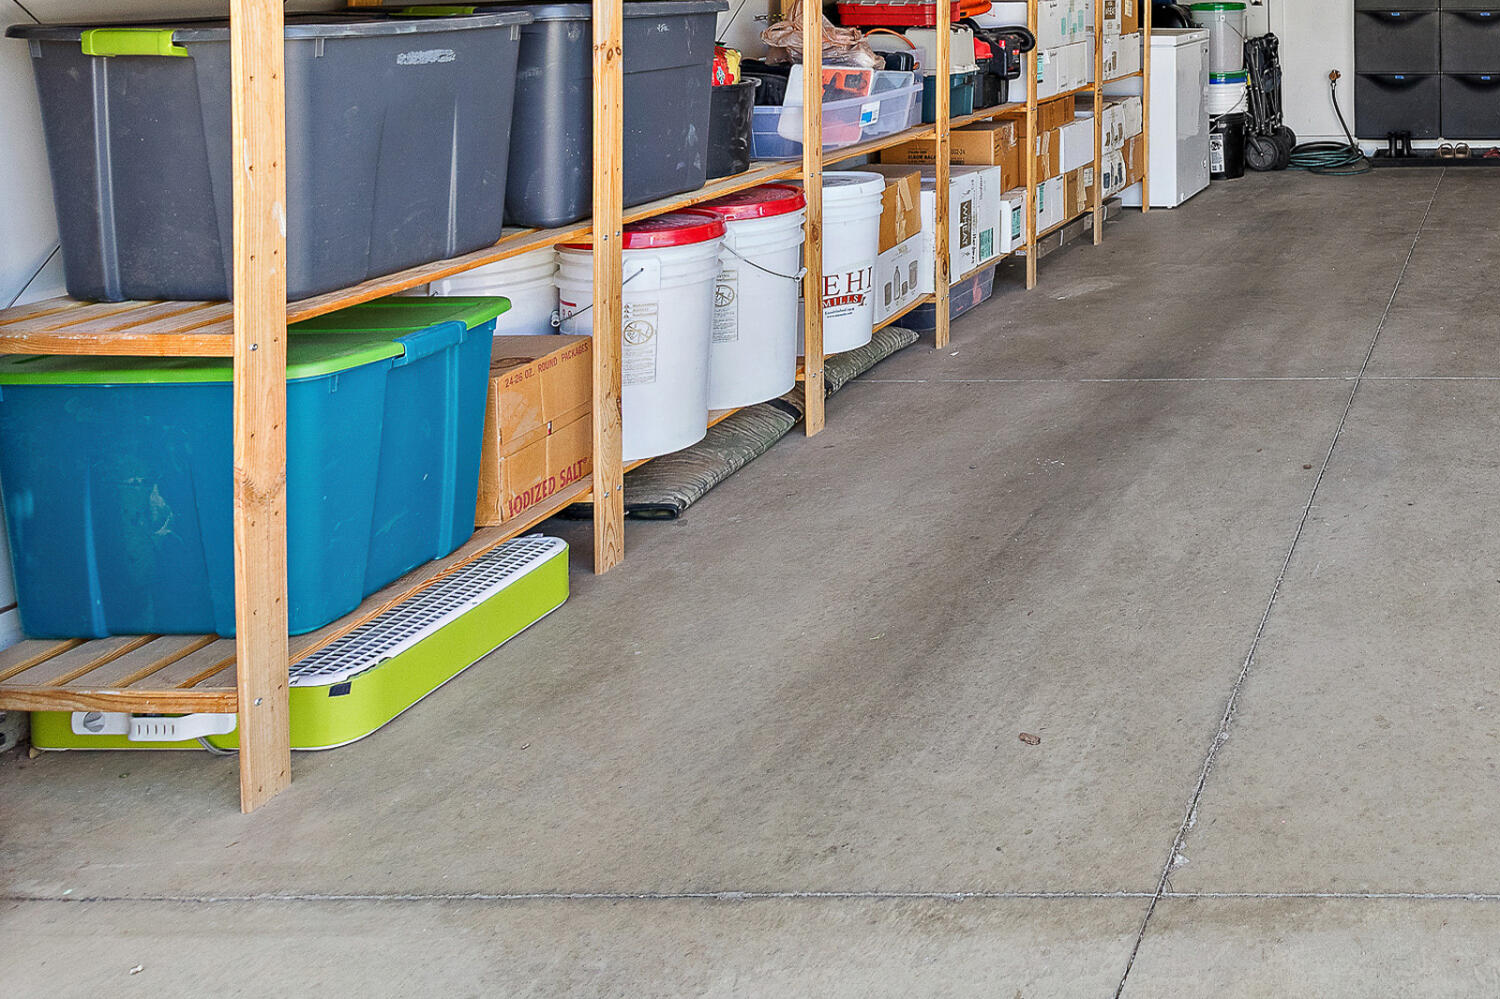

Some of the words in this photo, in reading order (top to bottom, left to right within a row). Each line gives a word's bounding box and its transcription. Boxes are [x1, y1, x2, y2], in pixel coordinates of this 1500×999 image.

[960, 201, 971, 247] WHEAT
[822, 294, 860, 309] MILLS
[823, 266, 873, 297] EHI
[504, 372, 523, 388] 24-26
[537, 356, 558, 373] ROUND
[561, 342, 589, 363] PACKAGES
[508, 476, 556, 518] IODIZED
